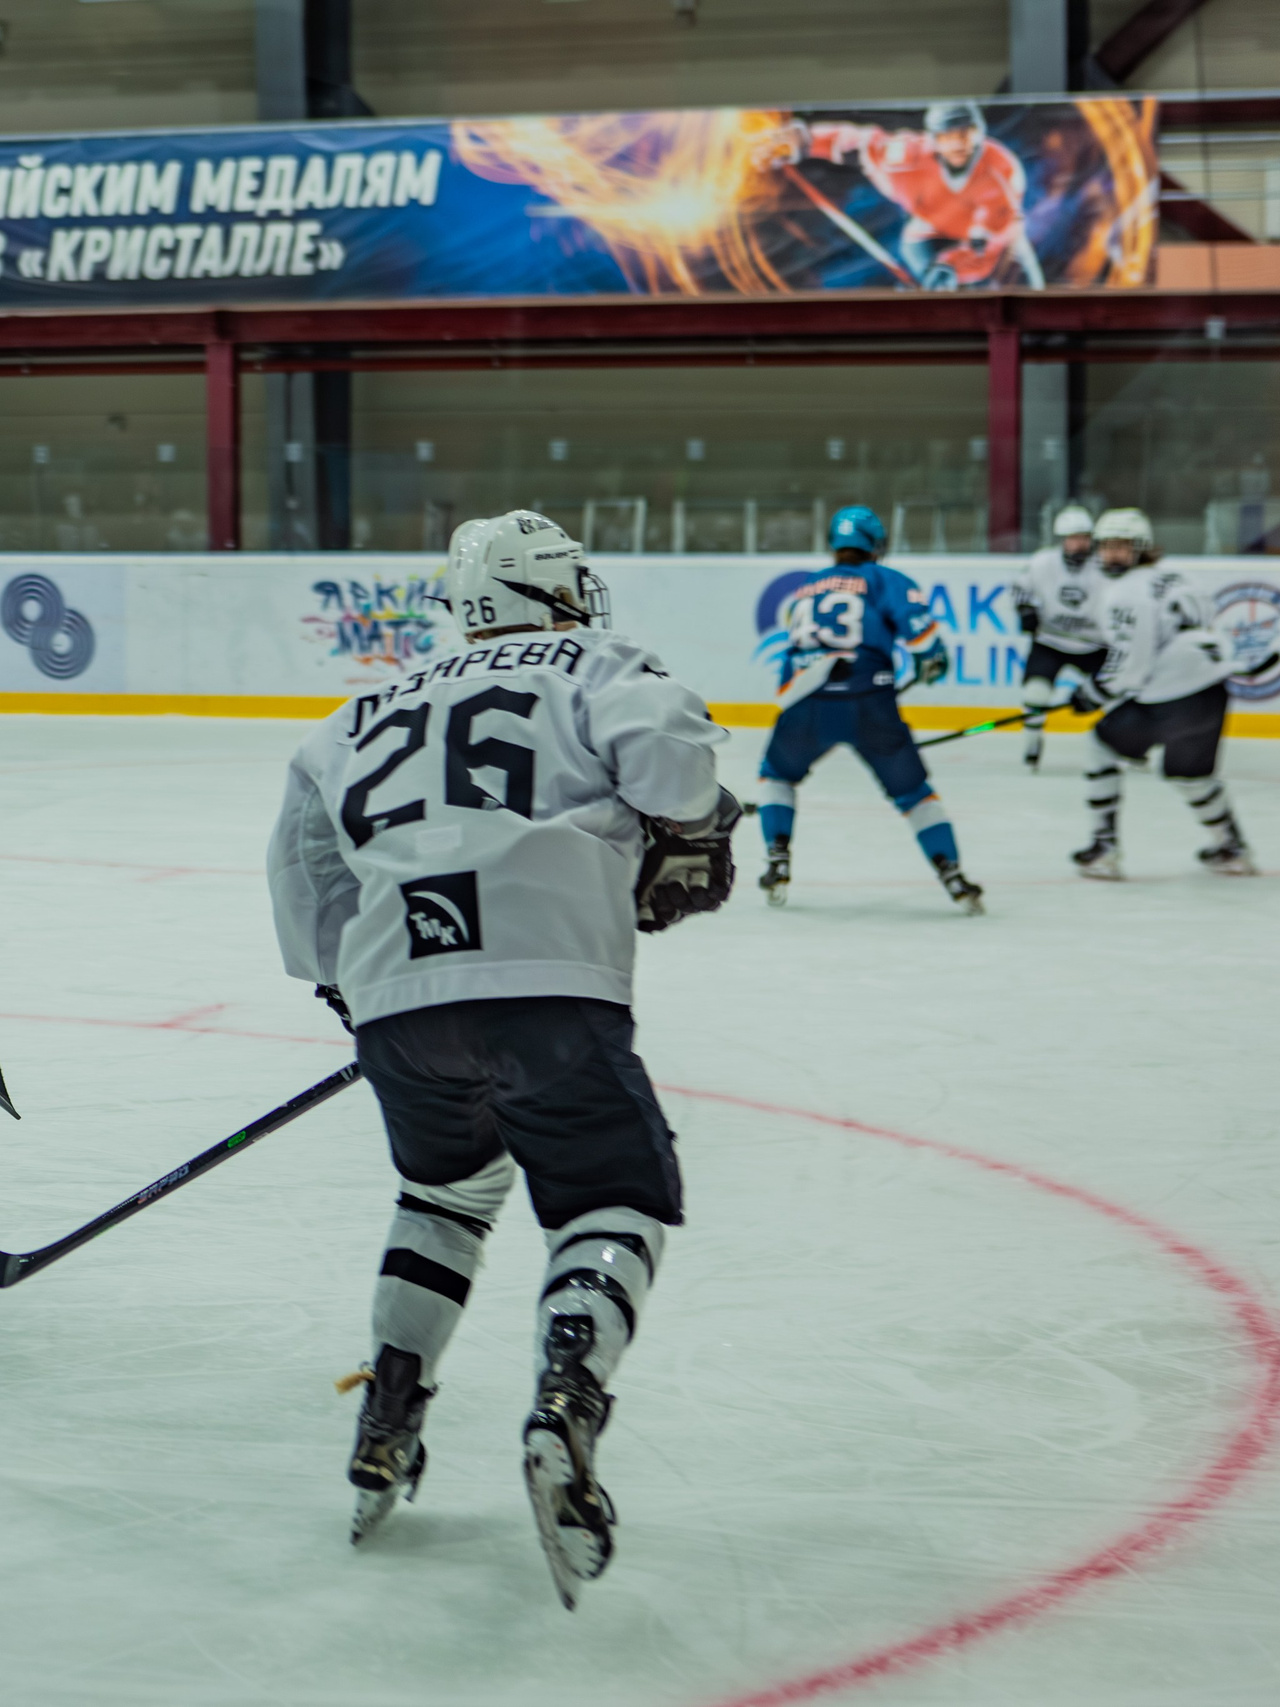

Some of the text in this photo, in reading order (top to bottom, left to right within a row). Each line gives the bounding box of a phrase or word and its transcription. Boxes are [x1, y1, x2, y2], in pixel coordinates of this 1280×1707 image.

[190, 150, 442, 217] МЕДАЛЯМ
[21, 220, 346, 282] «КРИСТАЛЛЕ»
[462, 596, 497, 627] 26
[789, 590, 866, 651] 43
[340, 684, 542, 850] 26
[408, 911, 459, 947] ТМК
